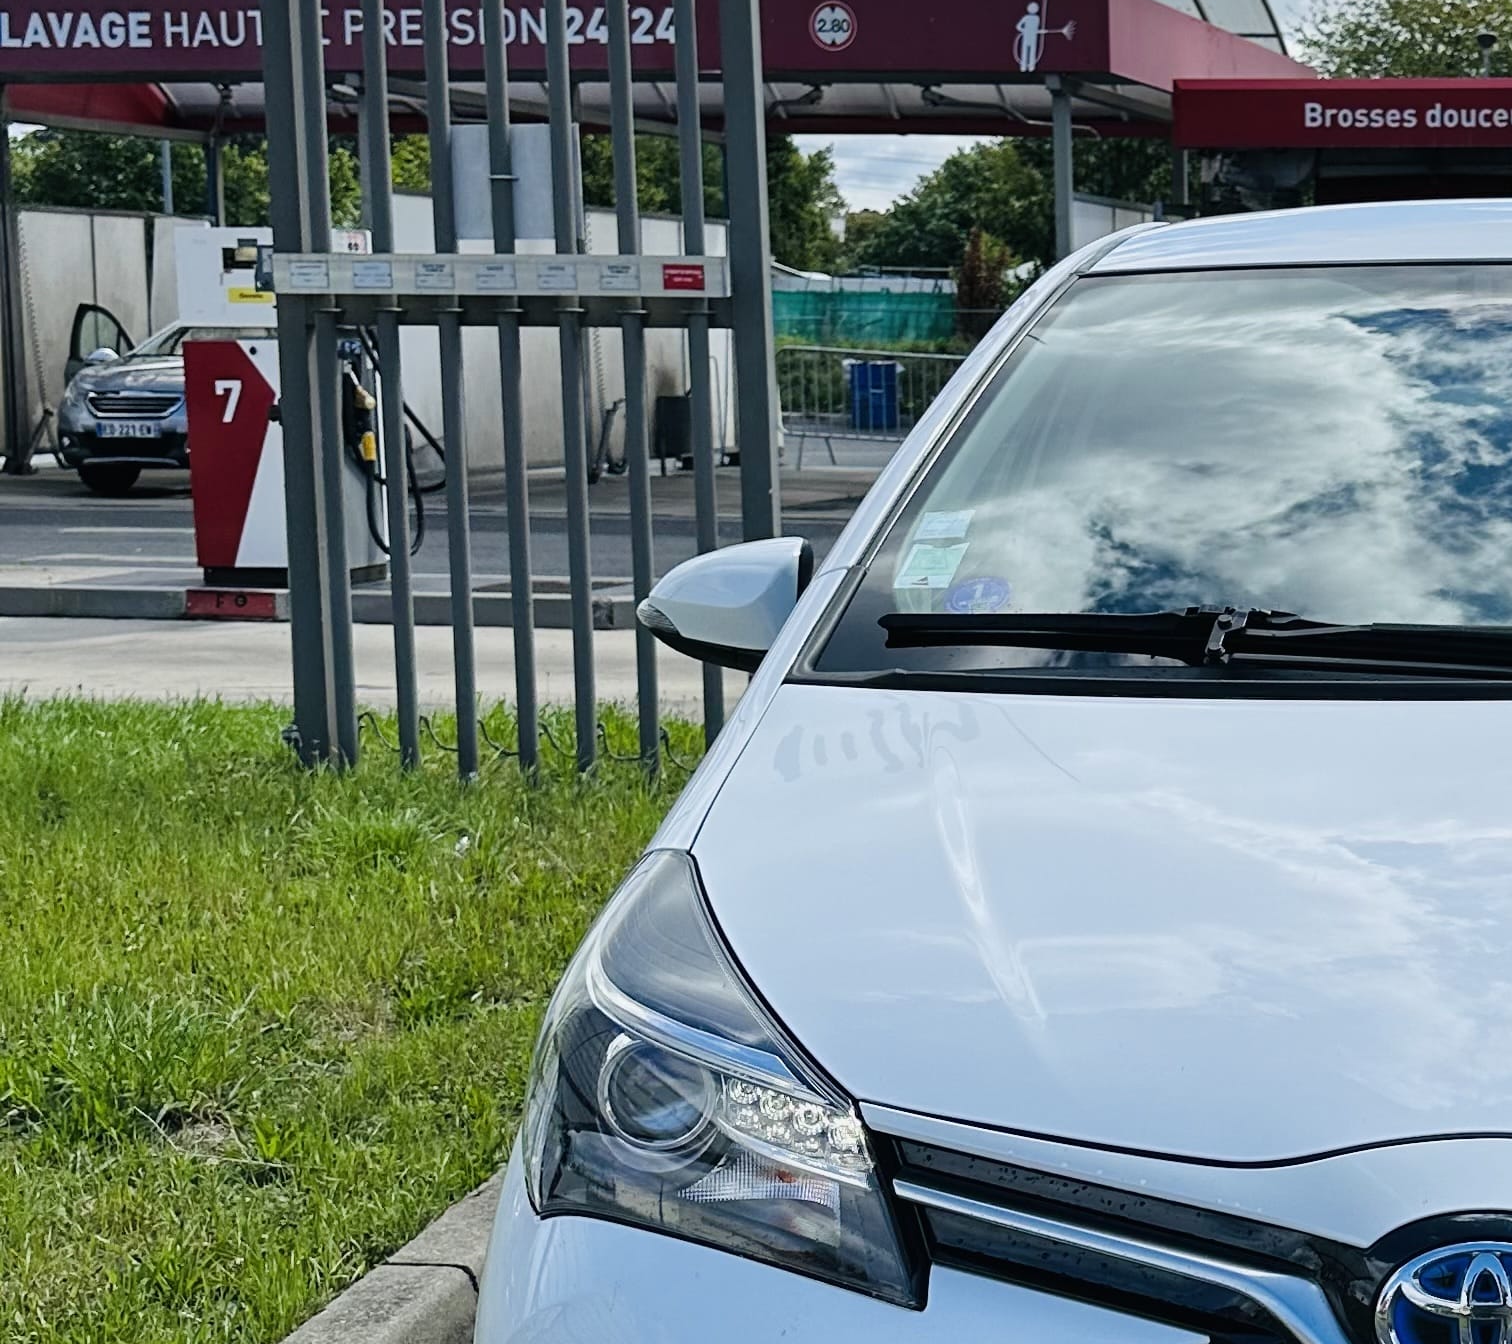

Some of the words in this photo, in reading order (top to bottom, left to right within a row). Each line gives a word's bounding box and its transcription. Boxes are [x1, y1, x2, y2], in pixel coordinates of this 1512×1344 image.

[1, 12, 152, 48] LAVAGE
[344, 8, 547, 46] PRESION
[1304, 102, 1417, 128] Brosses
[214, 379, 242, 423] 7
